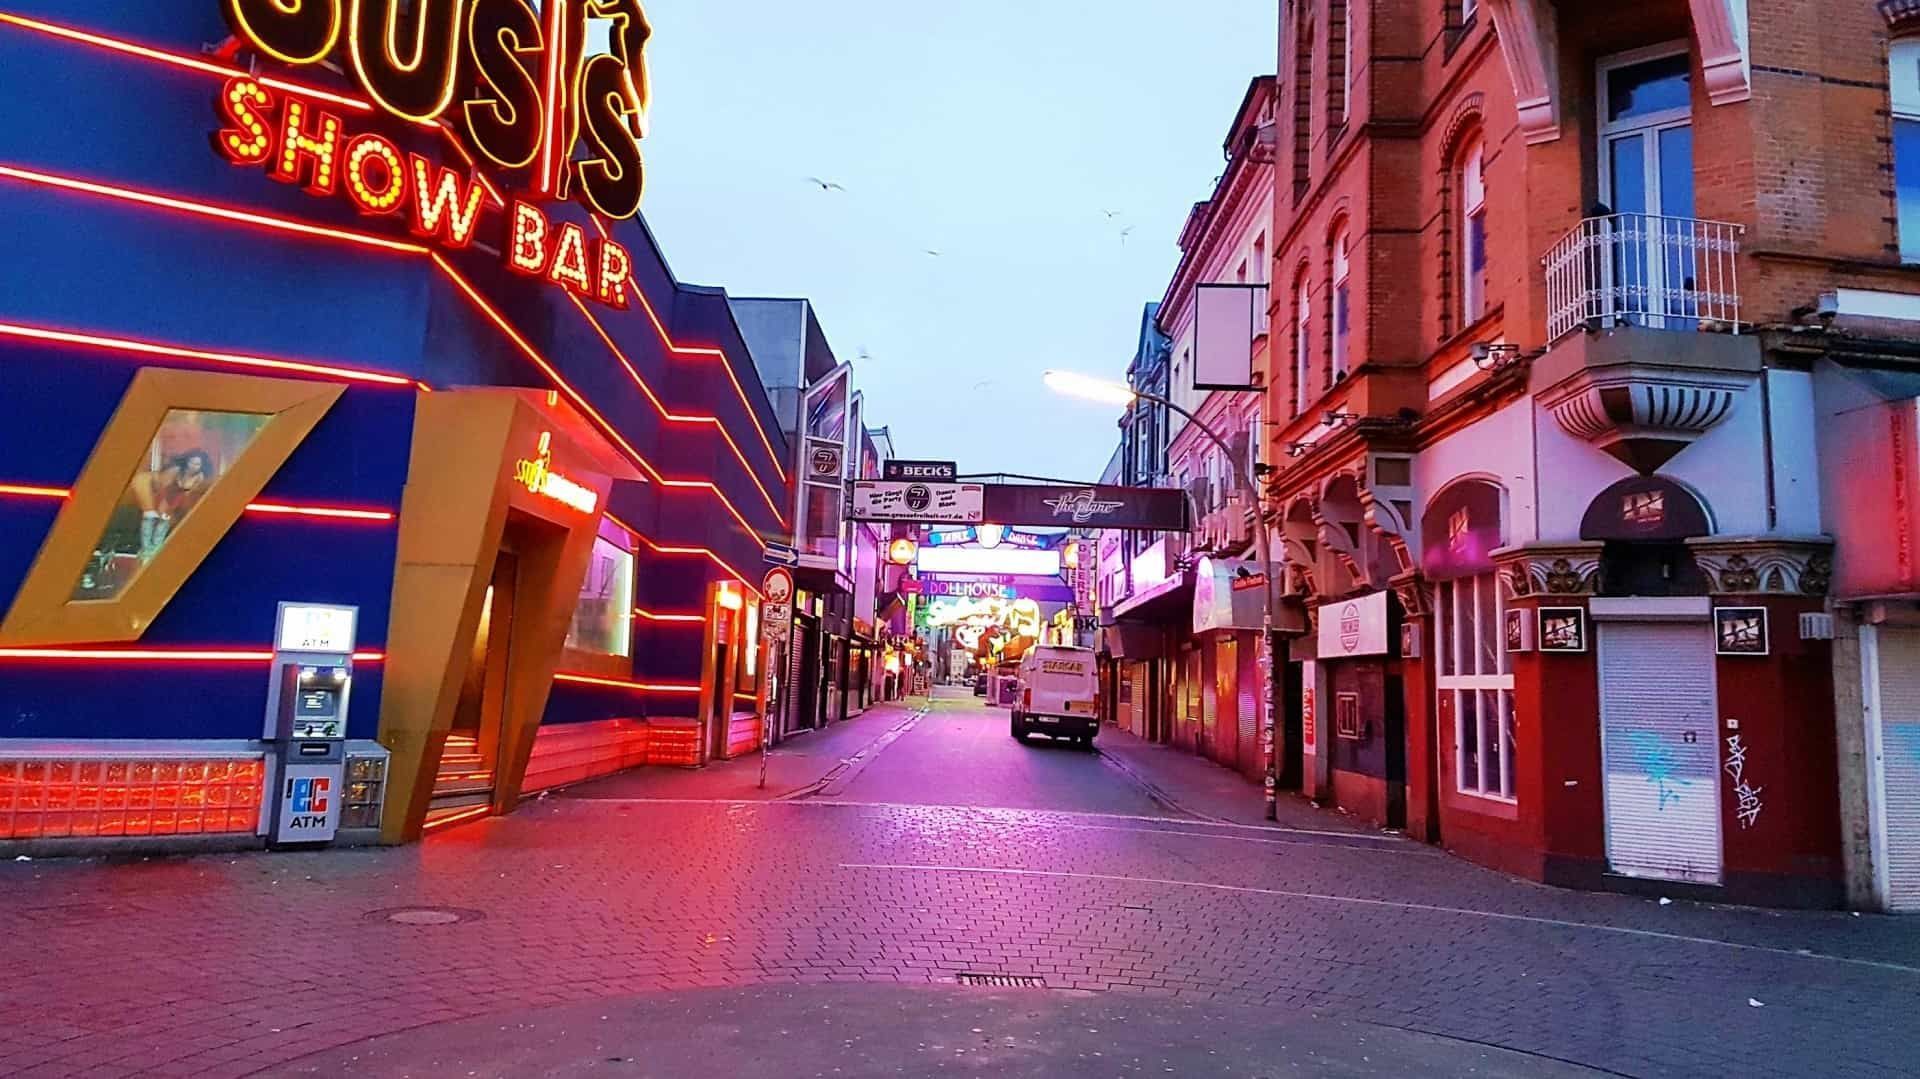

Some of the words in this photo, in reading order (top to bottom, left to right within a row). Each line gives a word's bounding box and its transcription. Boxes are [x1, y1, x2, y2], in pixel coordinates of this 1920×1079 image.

[224, 0, 650, 220] USIS
[218, 77, 487, 249] SHOW
[510, 200, 633, 310] BAR
[929, 582, 1008, 598] DOLLHOUSE
[289, 815, 327, 829] ATM
